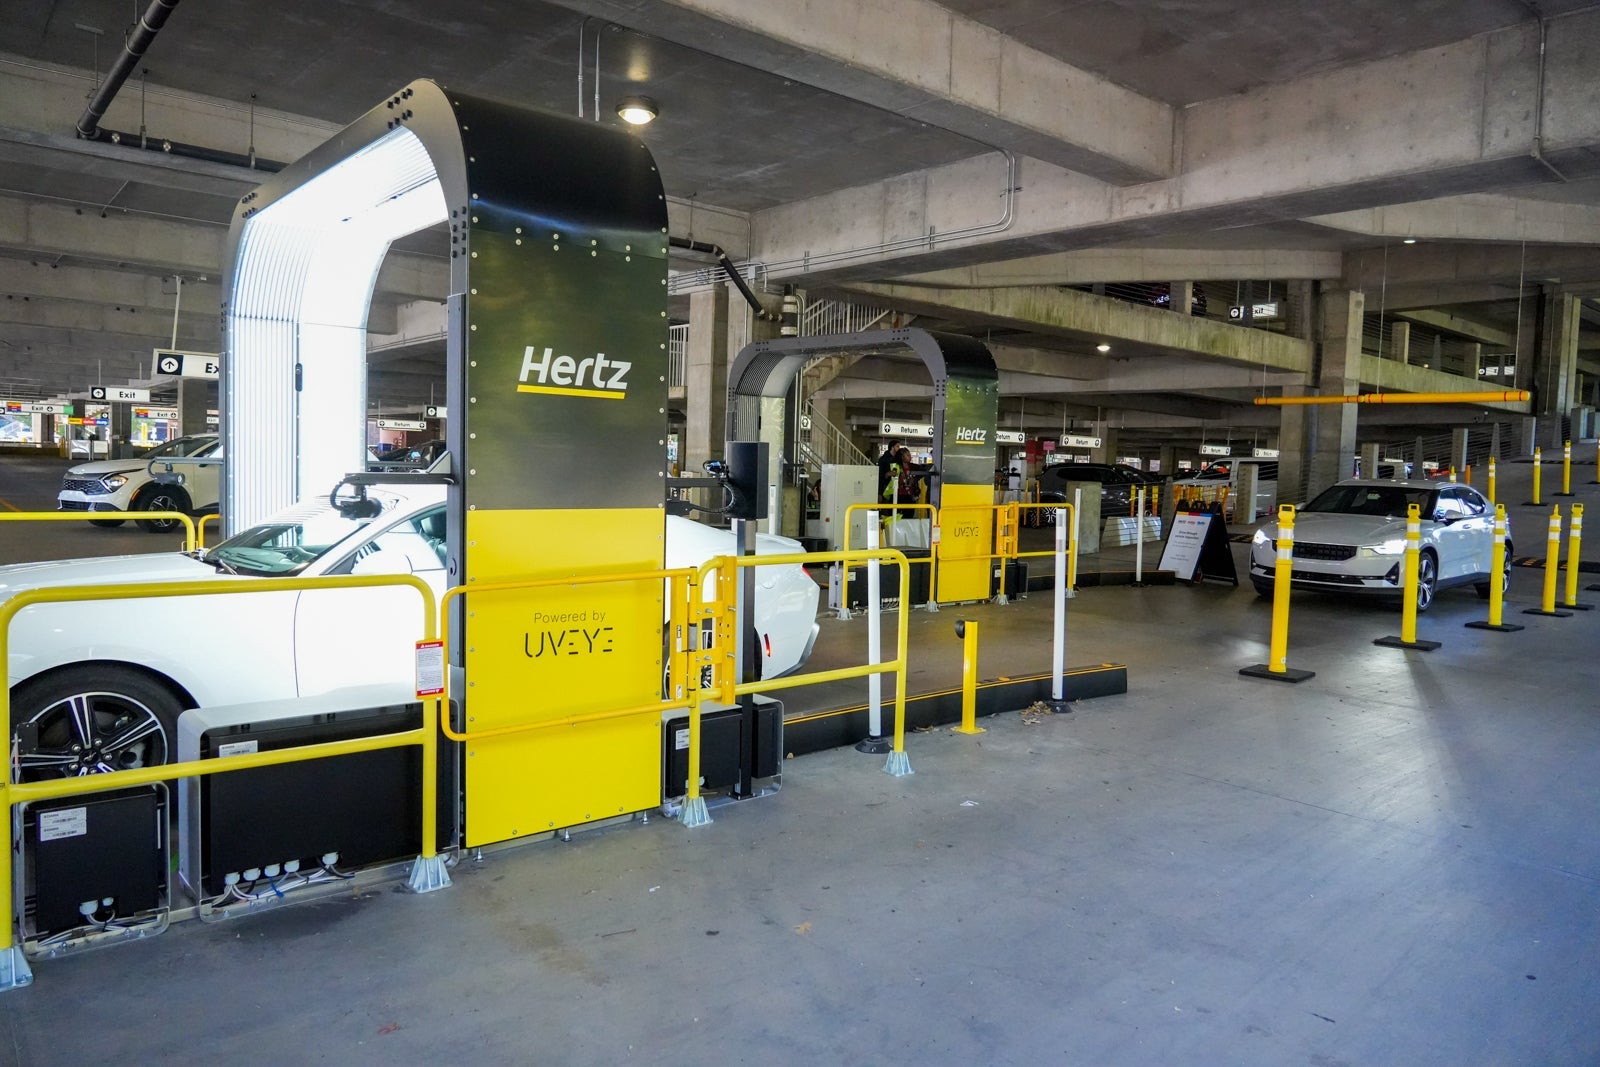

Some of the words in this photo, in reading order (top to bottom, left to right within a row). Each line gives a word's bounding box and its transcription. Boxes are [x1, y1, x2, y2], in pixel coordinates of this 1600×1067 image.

[519, 346, 632, 390] Hertz
[119, 391, 136, 399] Exit
[900, 426, 918, 434] Return
[956, 426, 987, 441] Hertz
[534, 610, 587, 624] Powered
[592, 610, 606, 623] by
[525, 627, 613, 658] UVEYE
